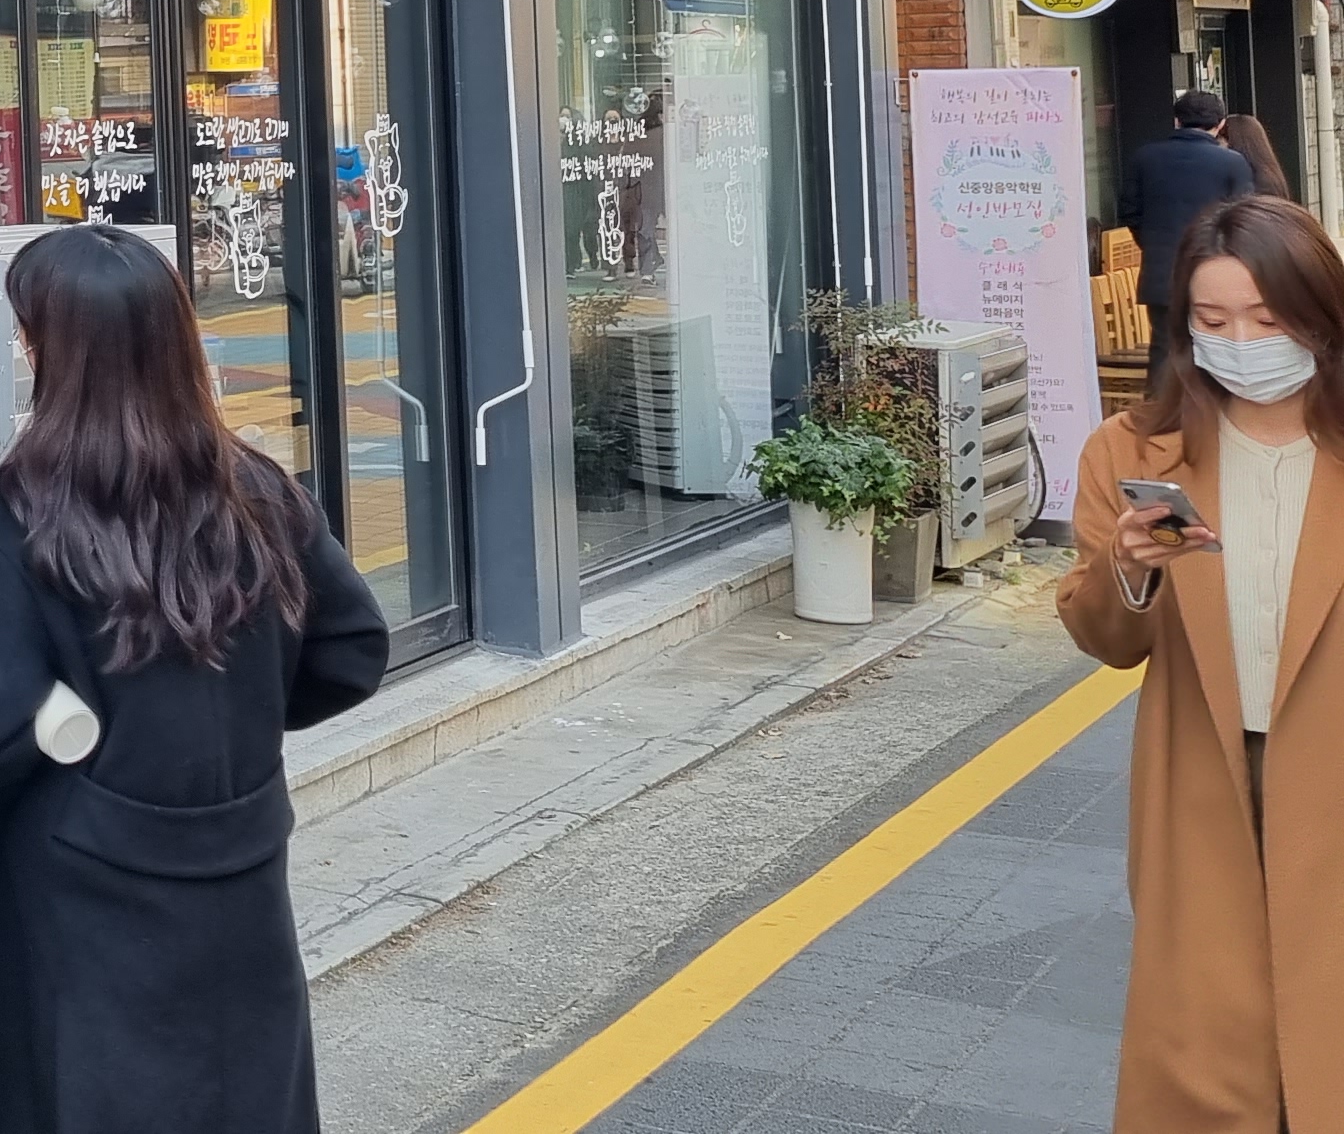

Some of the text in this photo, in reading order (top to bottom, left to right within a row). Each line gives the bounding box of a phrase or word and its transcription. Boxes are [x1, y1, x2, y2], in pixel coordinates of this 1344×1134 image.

[42, 172, 71, 207] 맛을
[93, 169, 147, 204] 했습니다
[192, 162, 215, 196] 맛을
